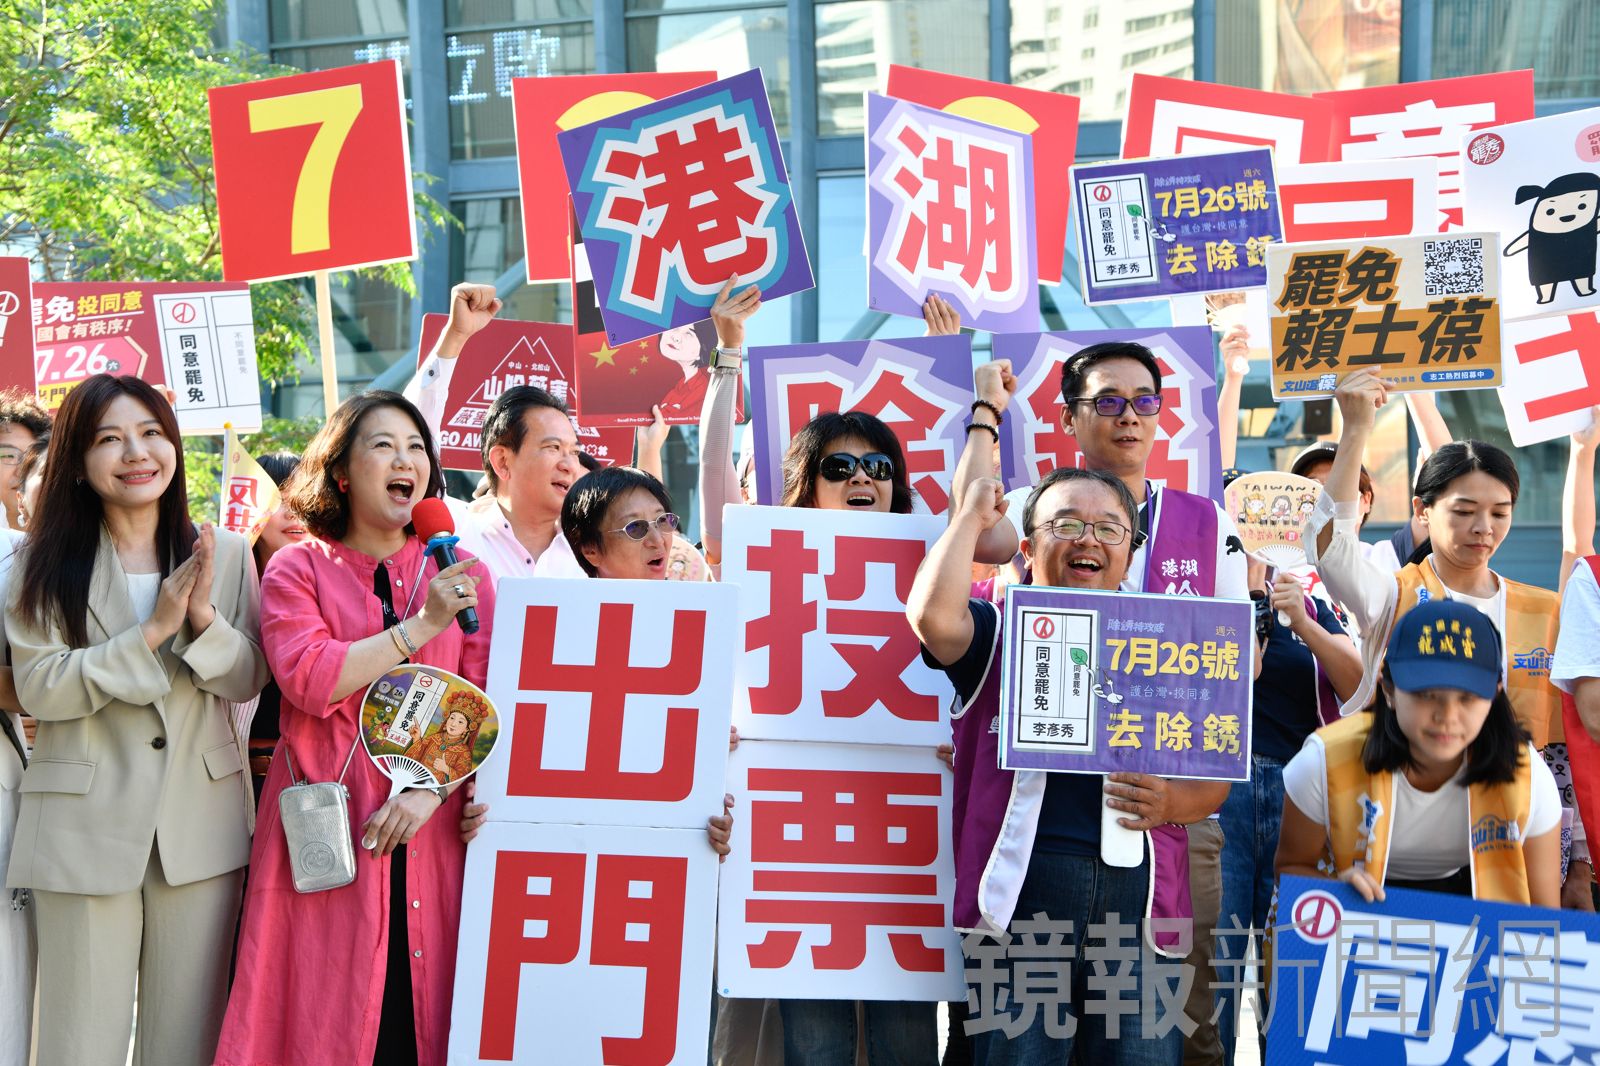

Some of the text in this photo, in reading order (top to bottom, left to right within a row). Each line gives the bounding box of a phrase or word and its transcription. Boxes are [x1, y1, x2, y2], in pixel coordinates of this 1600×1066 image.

[247, 83, 363, 255] 7
[1154, 179, 1269, 219] 7月26號
[1243, 168, 1262, 178] 週六
[603, 116, 769, 302] 港
[892, 124, 1013, 292] 湖
[1099, 207, 1117, 256] 同意罷免
[1279, 248, 1398, 308] 罷免
[36, 343, 108, 382] 7.26
[1276, 297, 1493, 372] 賴士葆
[180, 334, 206, 403] 同意罷免
[1161, 558, 1199, 577] 港湖
[1105, 637, 1240, 681] 7月26號
[1215, 626, 1237, 637] 週六
[1034, 646, 1050, 711] 同意罷免
[744, 528, 946, 973] 投票
[1032, 722, 1075, 738] 李彥秀
[478, 602, 707, 1066] 出門
